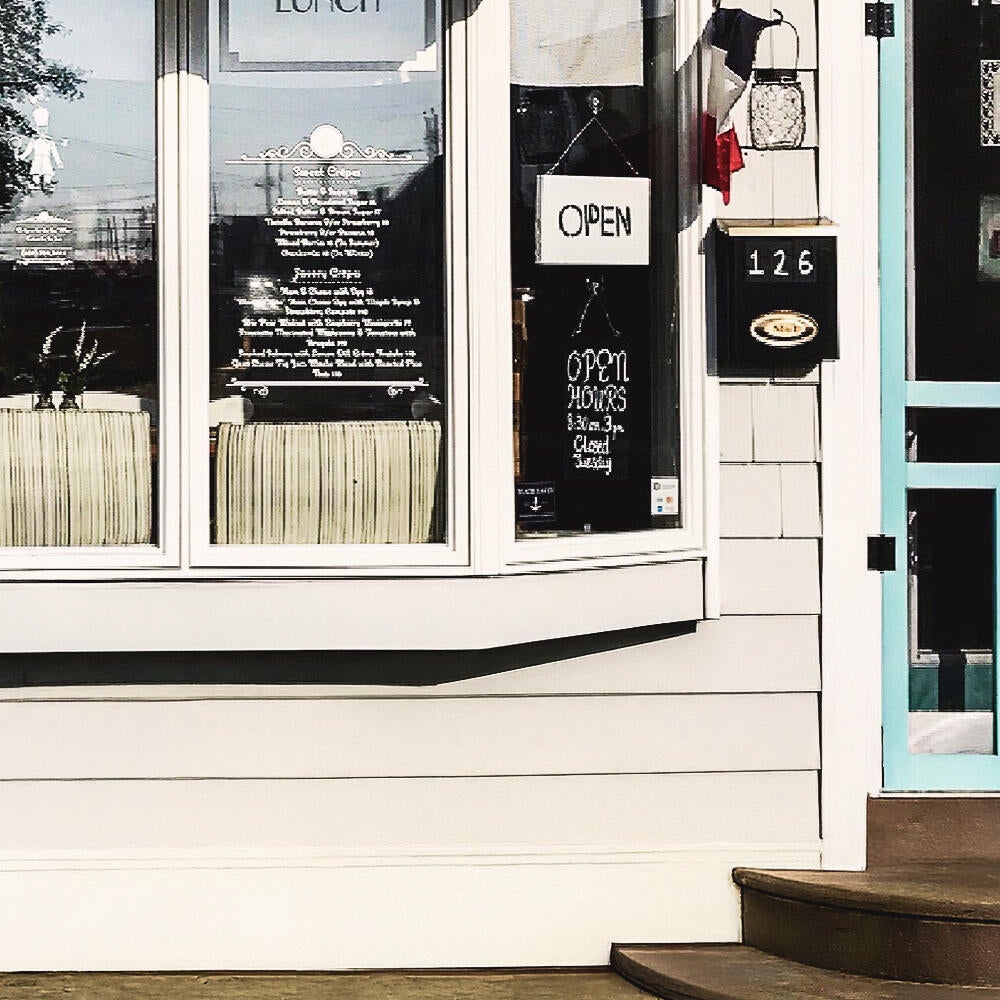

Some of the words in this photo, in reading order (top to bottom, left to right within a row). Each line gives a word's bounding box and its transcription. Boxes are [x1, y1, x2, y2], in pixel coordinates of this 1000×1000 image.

[558, 203, 631, 237] OPEN
[567, 349, 629, 382] OPEN
[567, 384, 627, 412] HOURS
